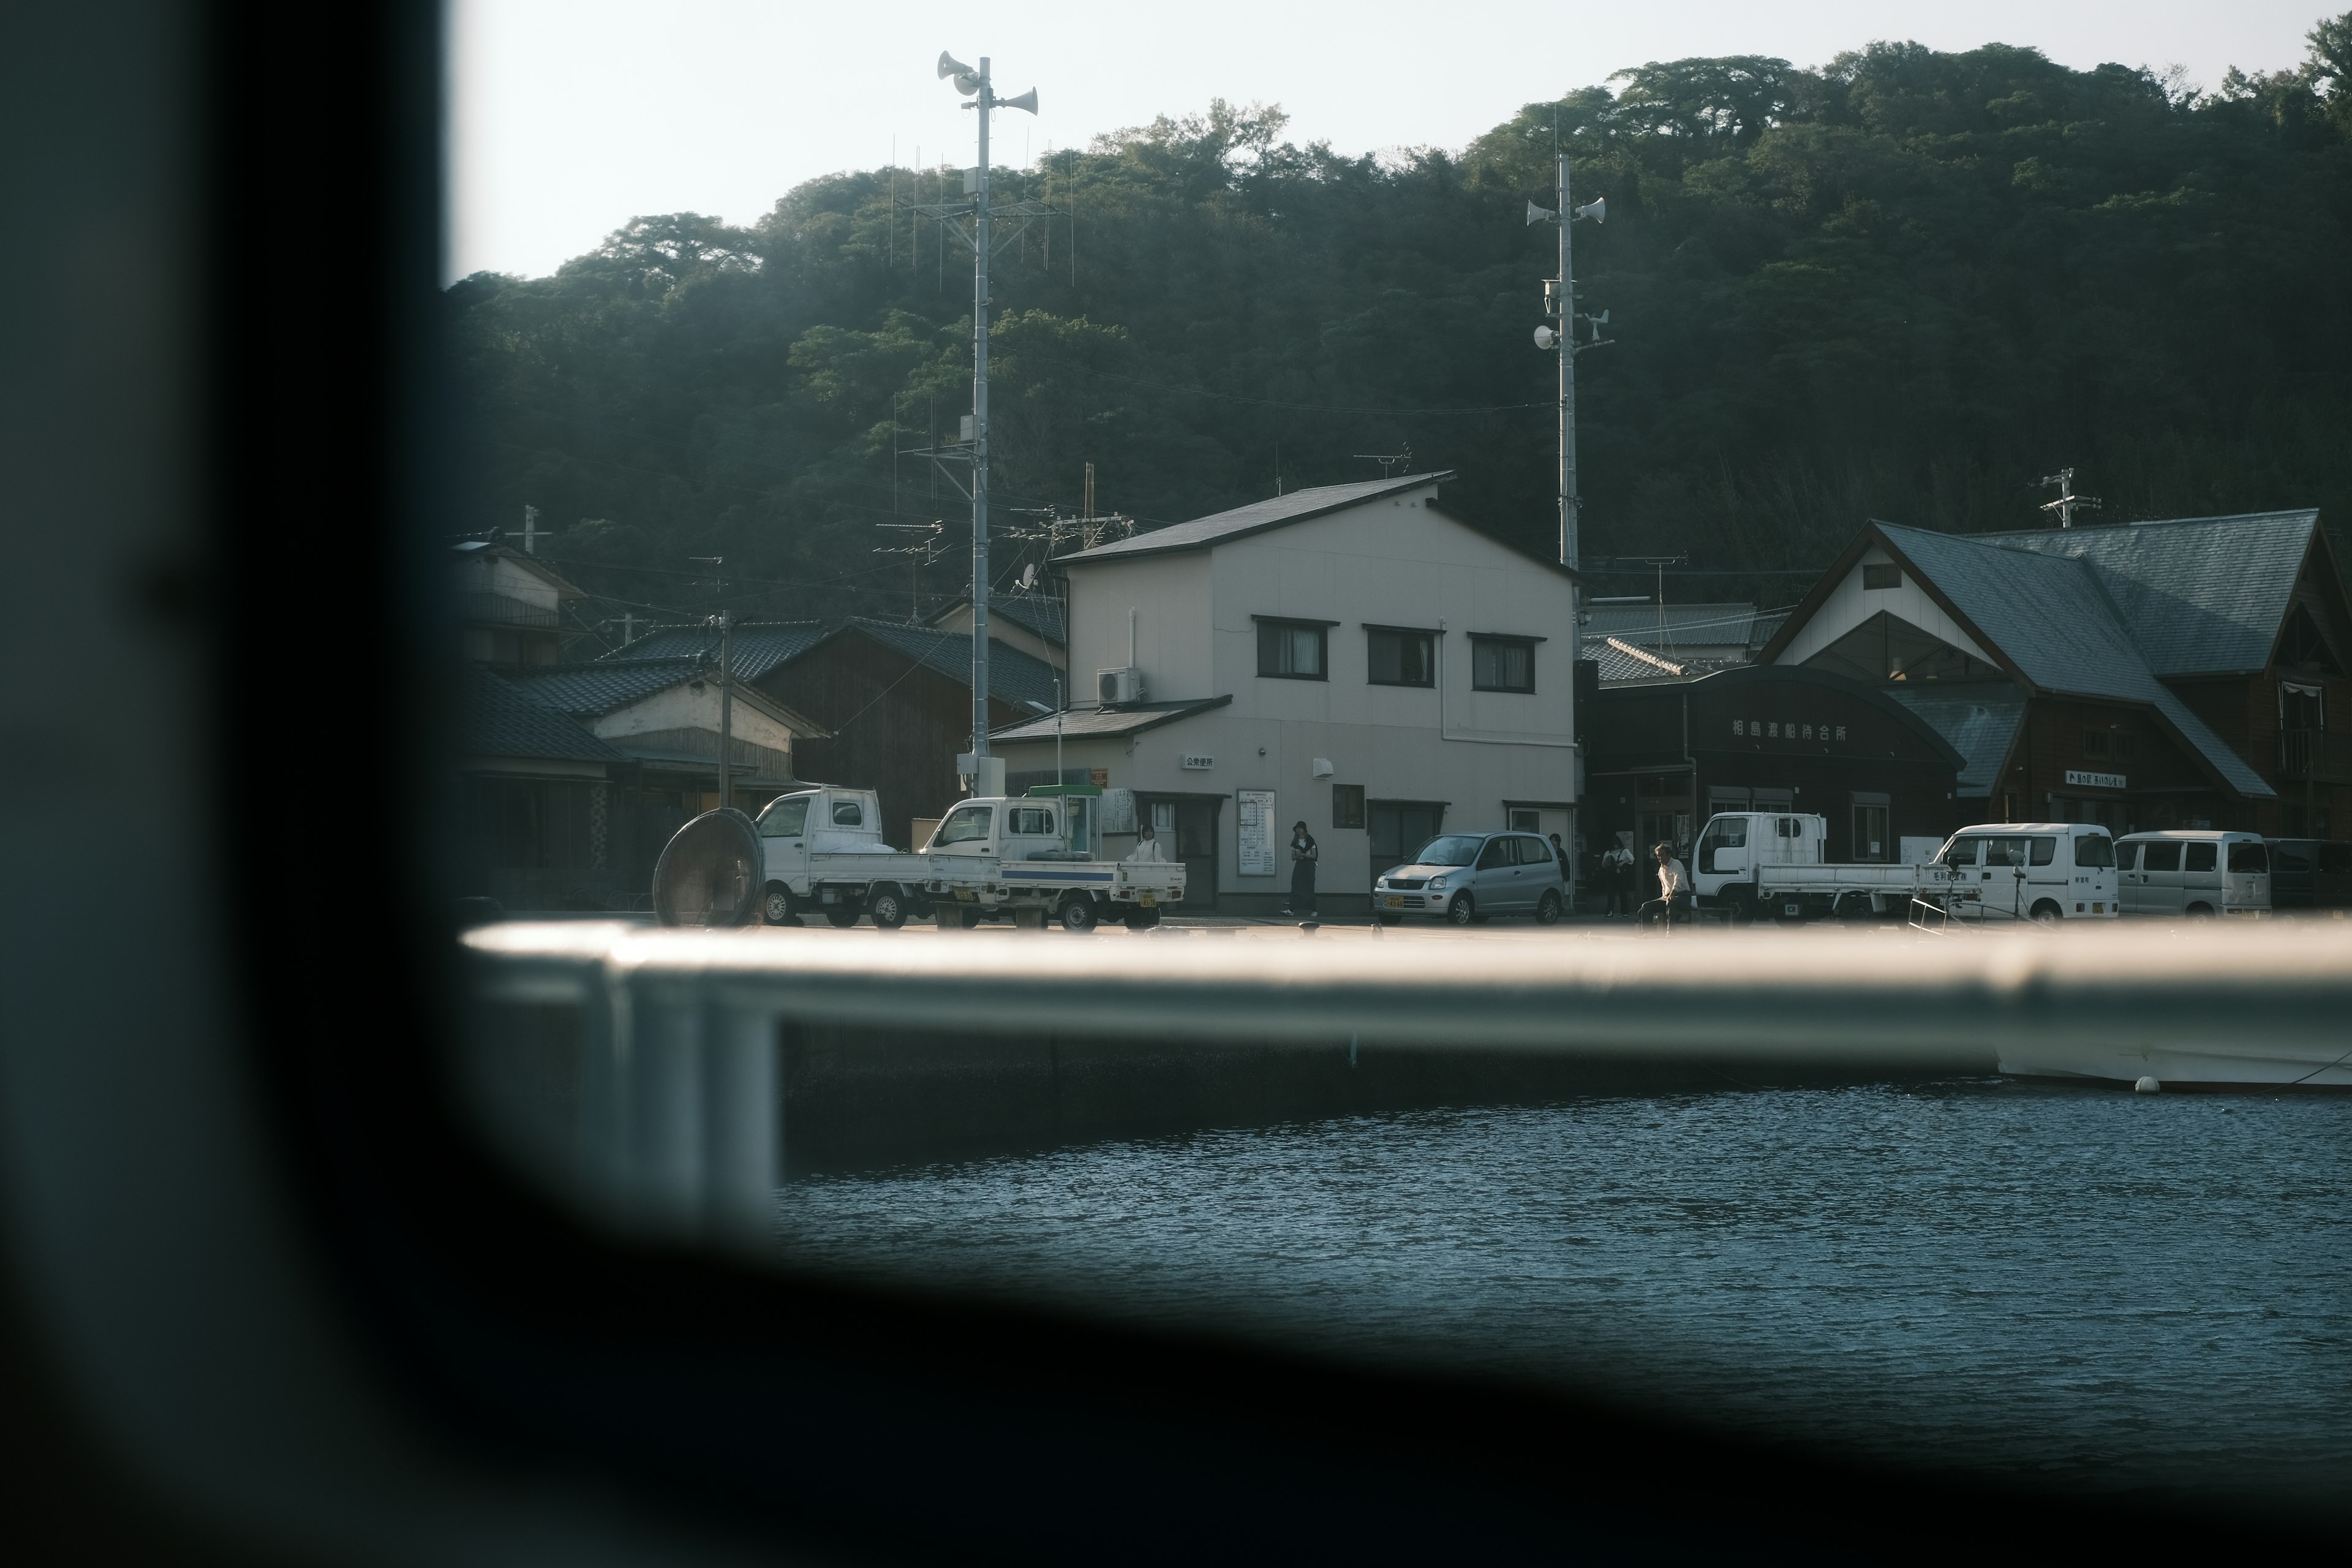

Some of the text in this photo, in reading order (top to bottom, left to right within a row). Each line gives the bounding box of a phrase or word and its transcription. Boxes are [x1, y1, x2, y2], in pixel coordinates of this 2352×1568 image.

[1732, 719, 1847, 742] 相島渡船待合所
[1186, 757, 1213, 767] 公衆便所
[2077, 773, 2092, 784] 島の駅
[2094, 775, 2117, 786] あいのしま
